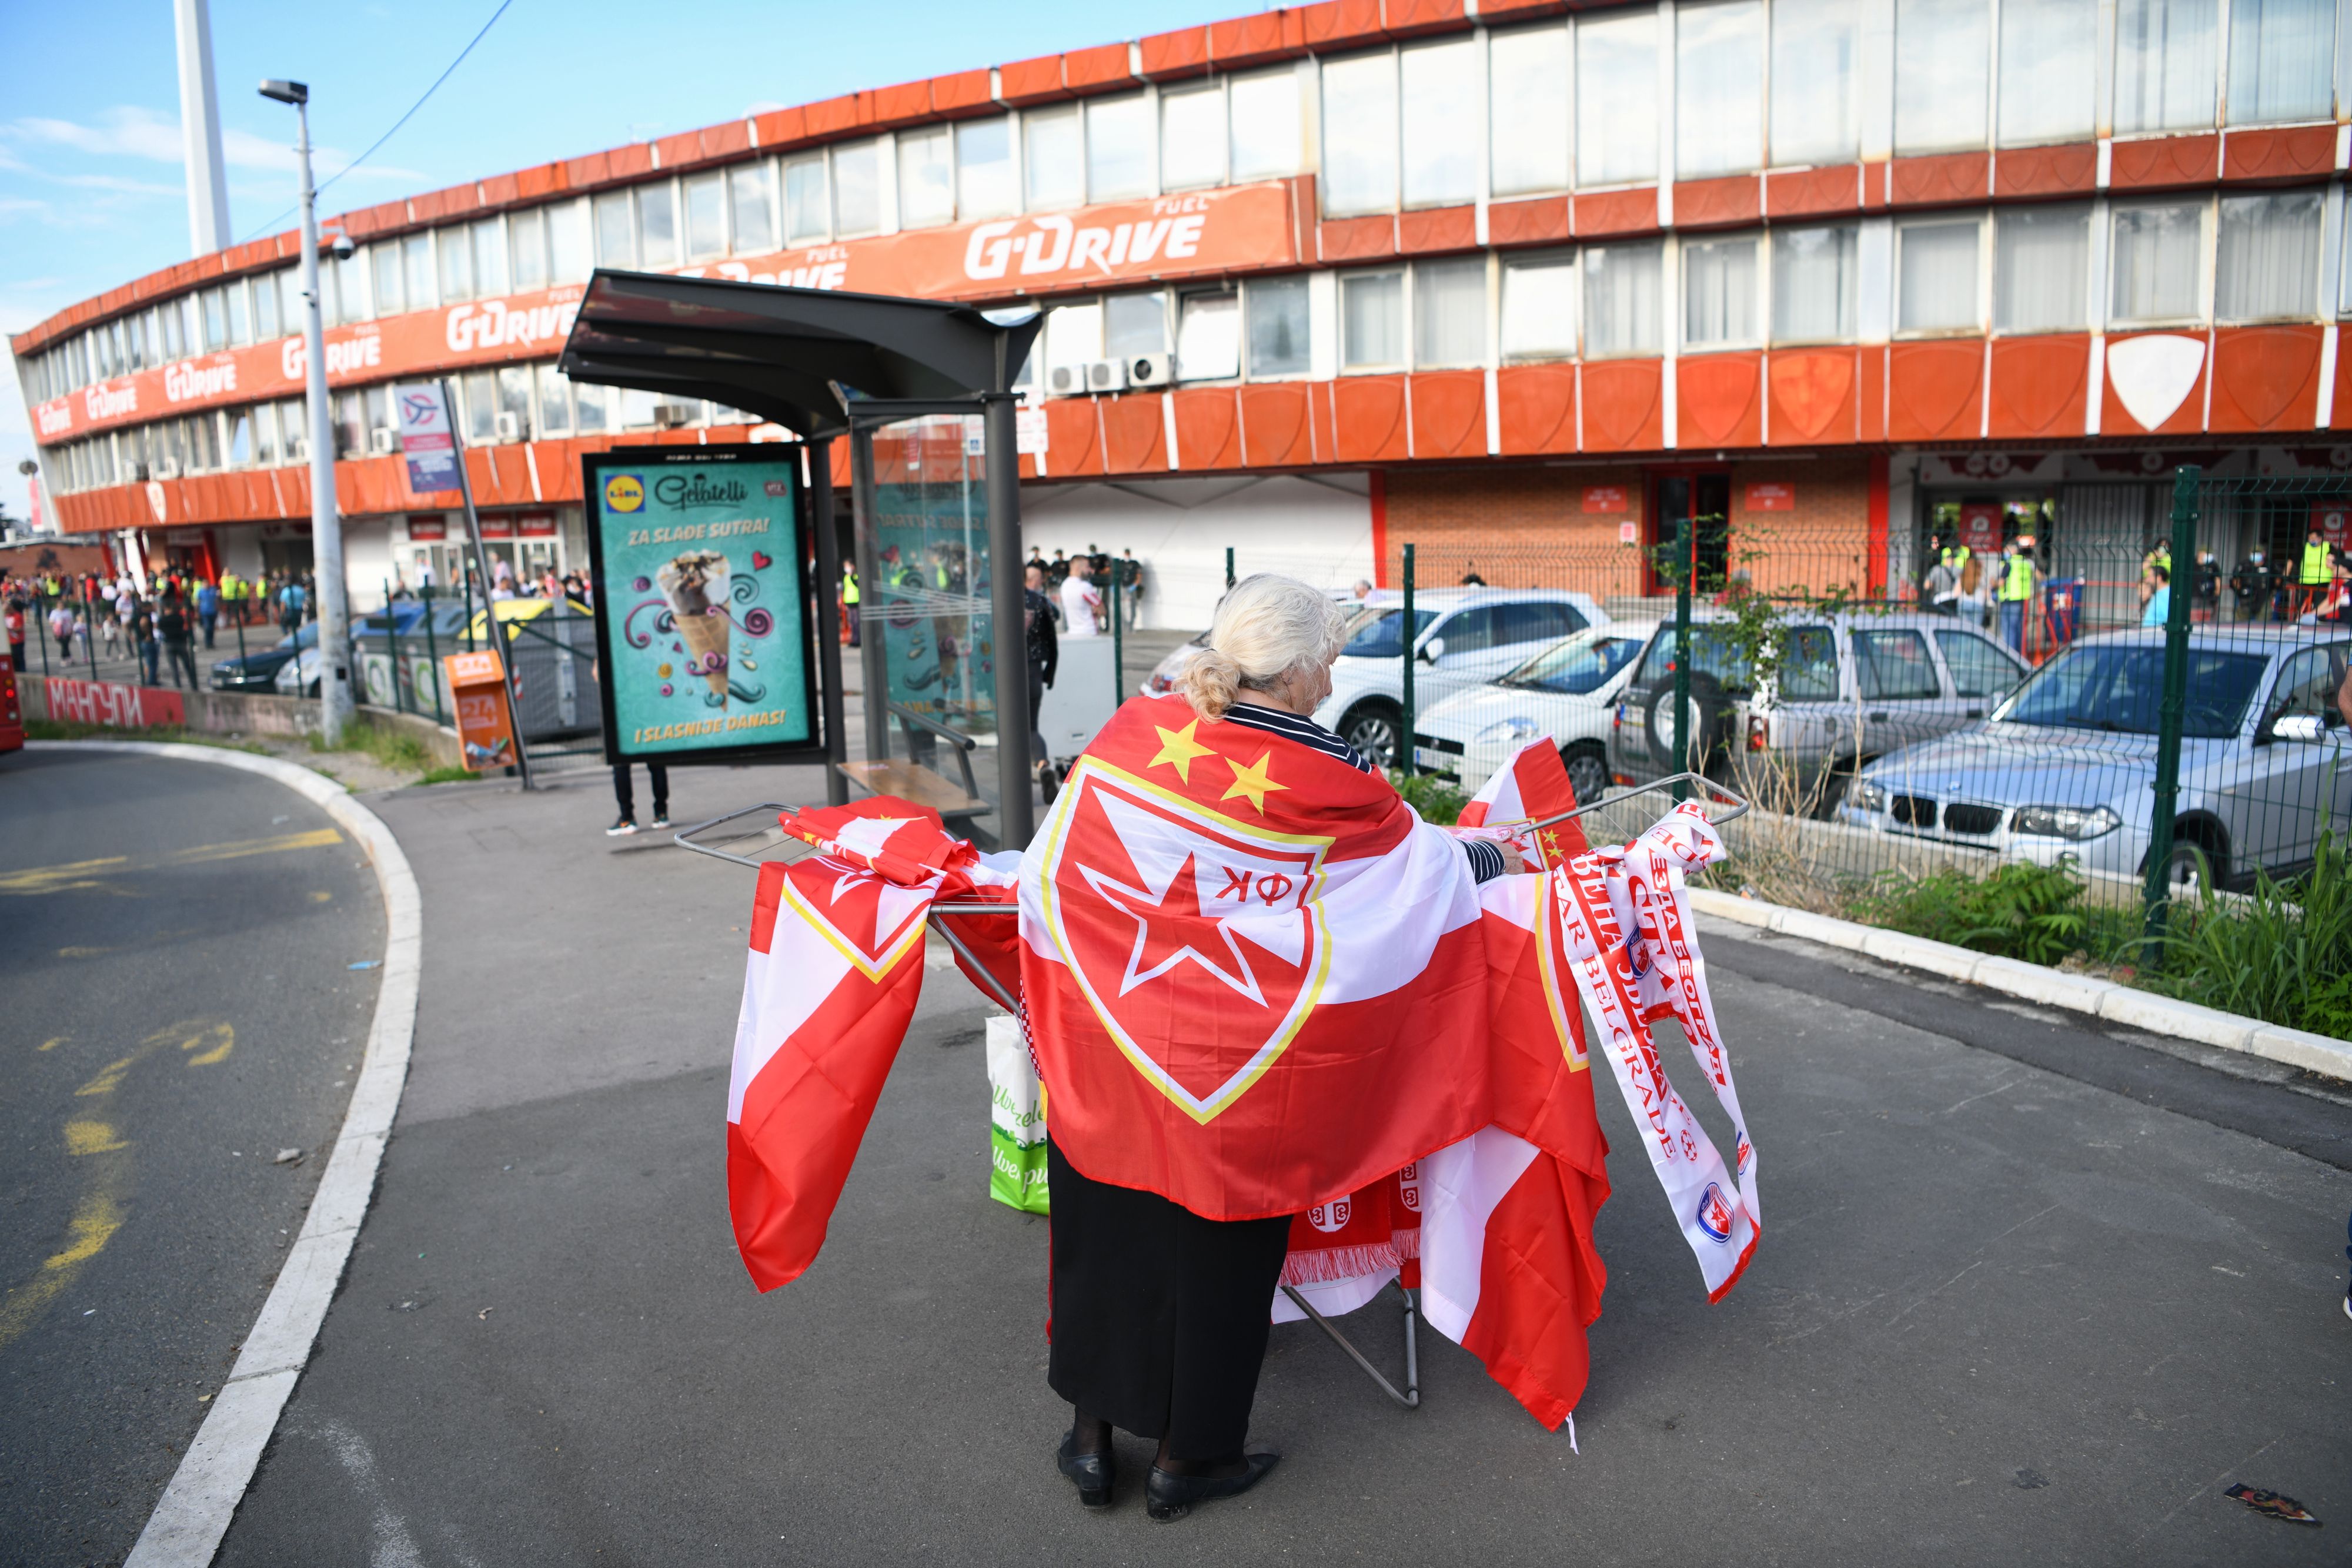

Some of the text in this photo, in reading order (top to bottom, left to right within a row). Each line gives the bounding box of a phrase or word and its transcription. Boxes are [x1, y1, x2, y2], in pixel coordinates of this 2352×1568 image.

[1154, 196, 1210, 215] FUEL
[628, 530, 650, 546] ZA
[709, 517, 770, 538] SUTRA!
[643, 717, 723, 743] SLASNIJE
[726, 710, 786, 731] DANAS!
[1672, 940, 1722, 1075] БЕОГРАД
[1581, 952, 1676, 1159] BELGRADE
